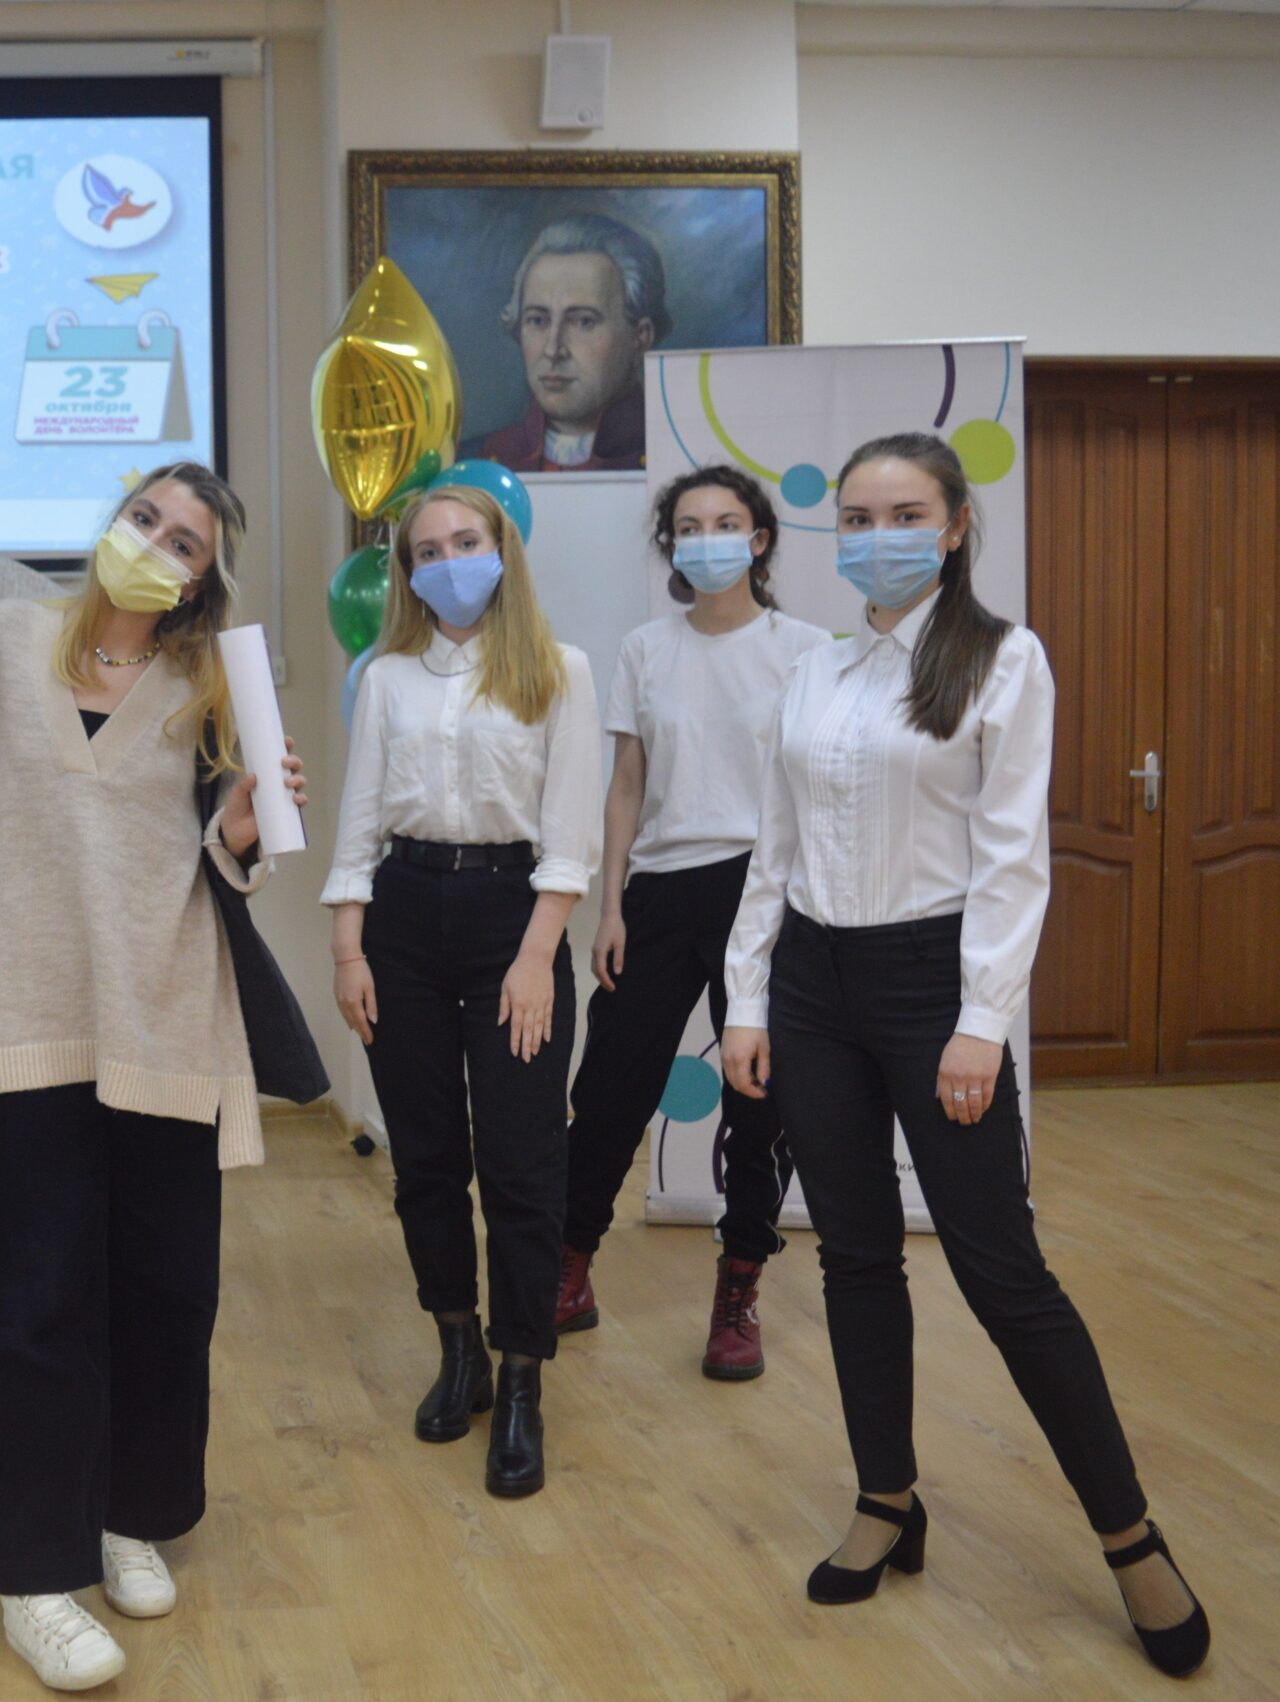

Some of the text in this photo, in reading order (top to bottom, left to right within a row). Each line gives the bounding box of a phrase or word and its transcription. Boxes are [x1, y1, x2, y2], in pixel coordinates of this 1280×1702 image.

[58, 365, 129, 398] 23
[44, 399, 132, 415] октября
[32, 425, 64, 435] ДЕНЬ
